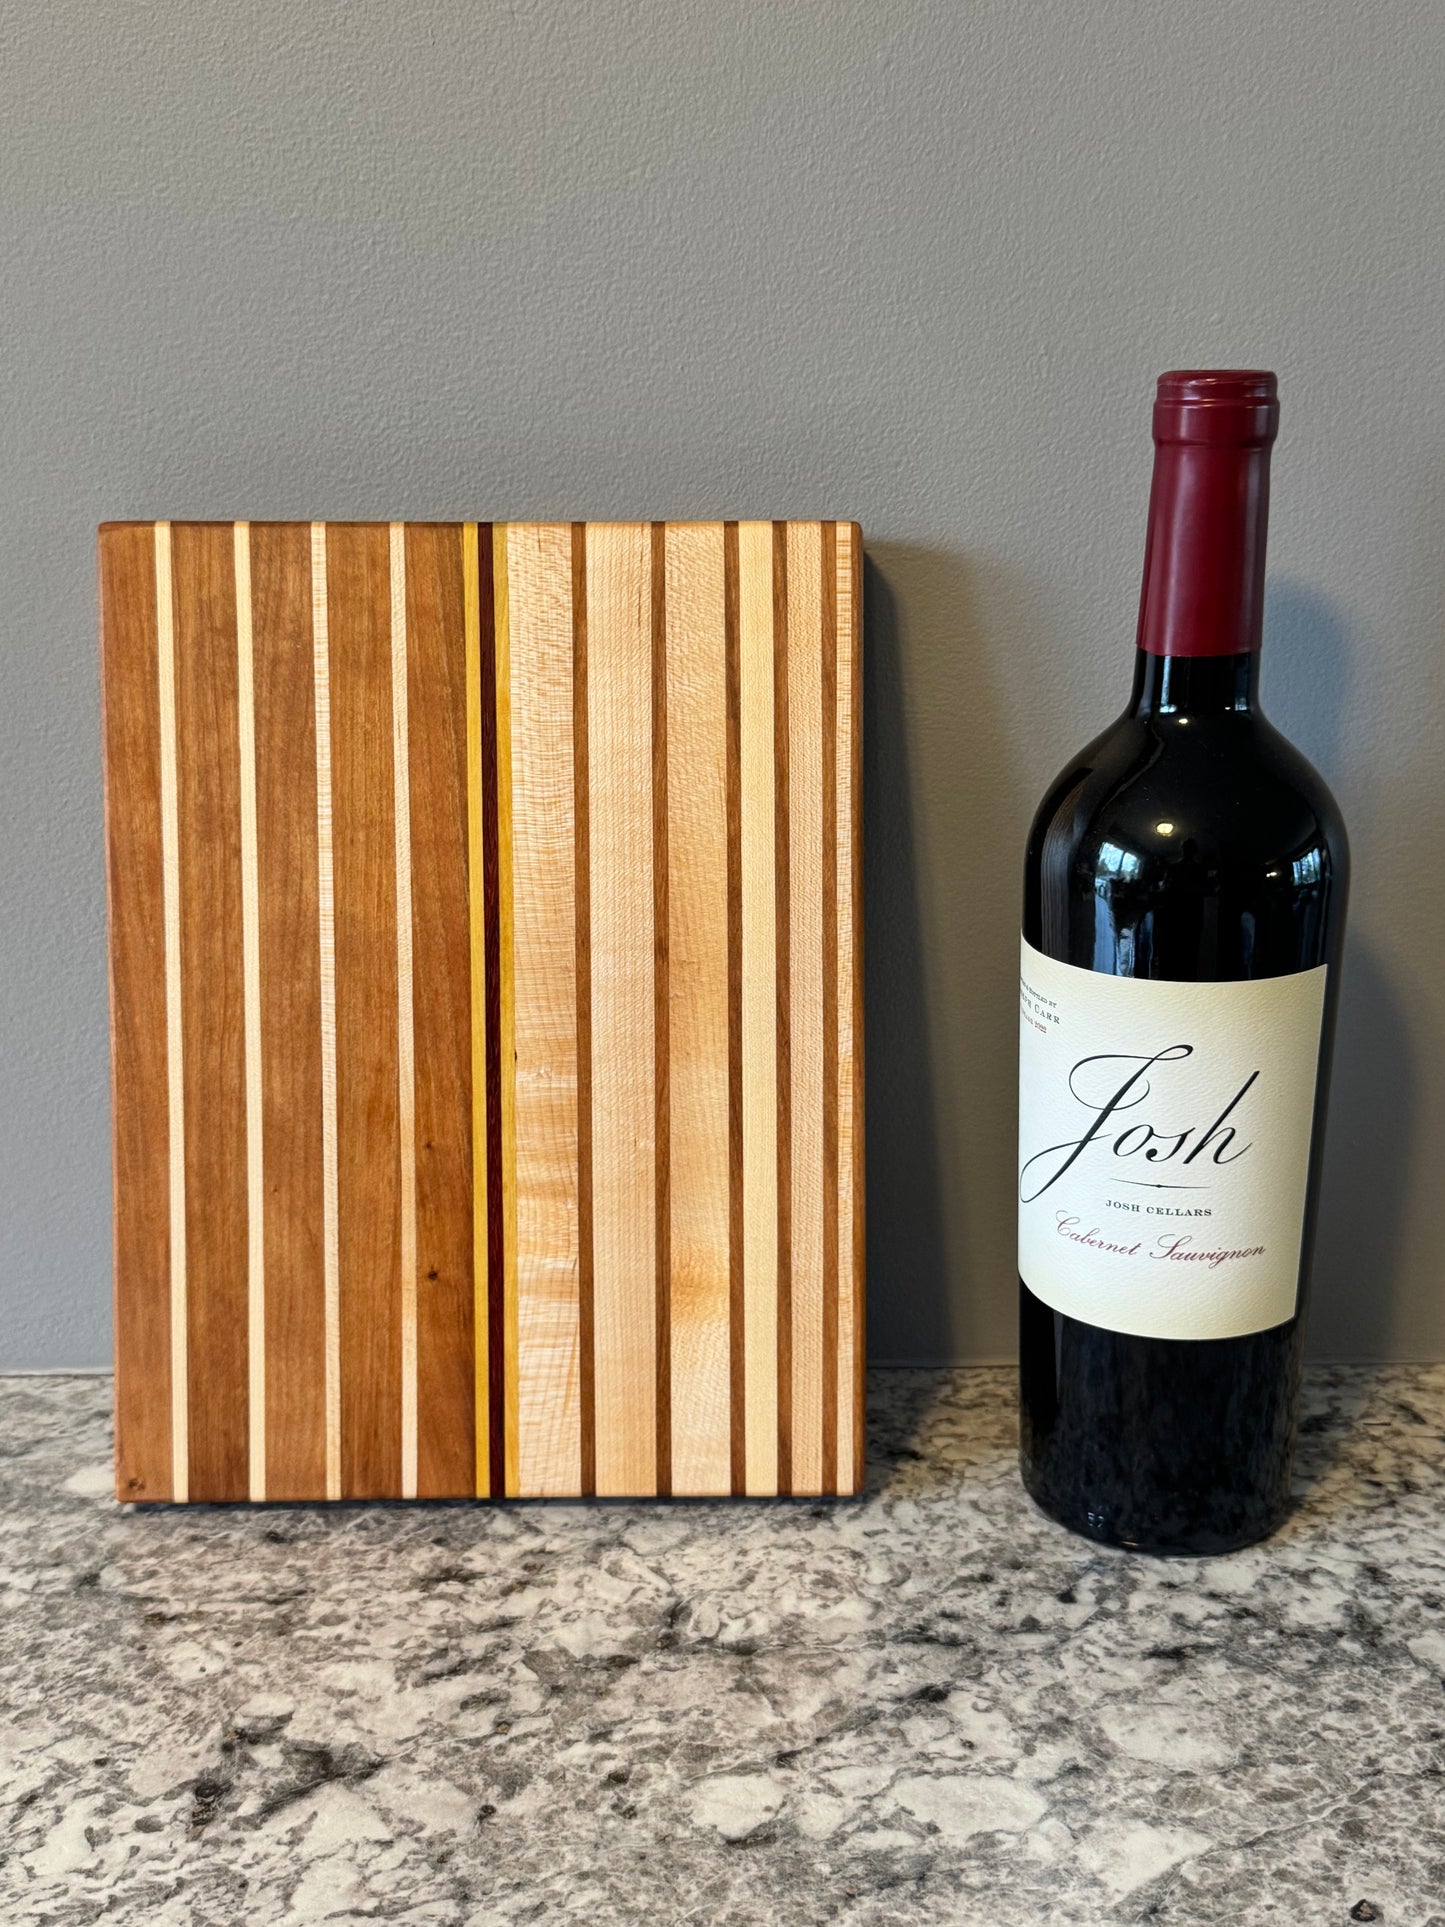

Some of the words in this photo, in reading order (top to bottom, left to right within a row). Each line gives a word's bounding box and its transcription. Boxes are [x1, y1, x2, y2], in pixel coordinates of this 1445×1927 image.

[1048, 1000, 1057, 1008] BY
[1019, 1044, 1260, 1204] Josh
[1105, 1199, 1141, 1213] JOSH
[1146, 1205, 1213, 1217] CELLARS
[1055, 1209, 1142, 1256] Cabernet
[1149, 1233, 1266, 1269] Sauvignon
